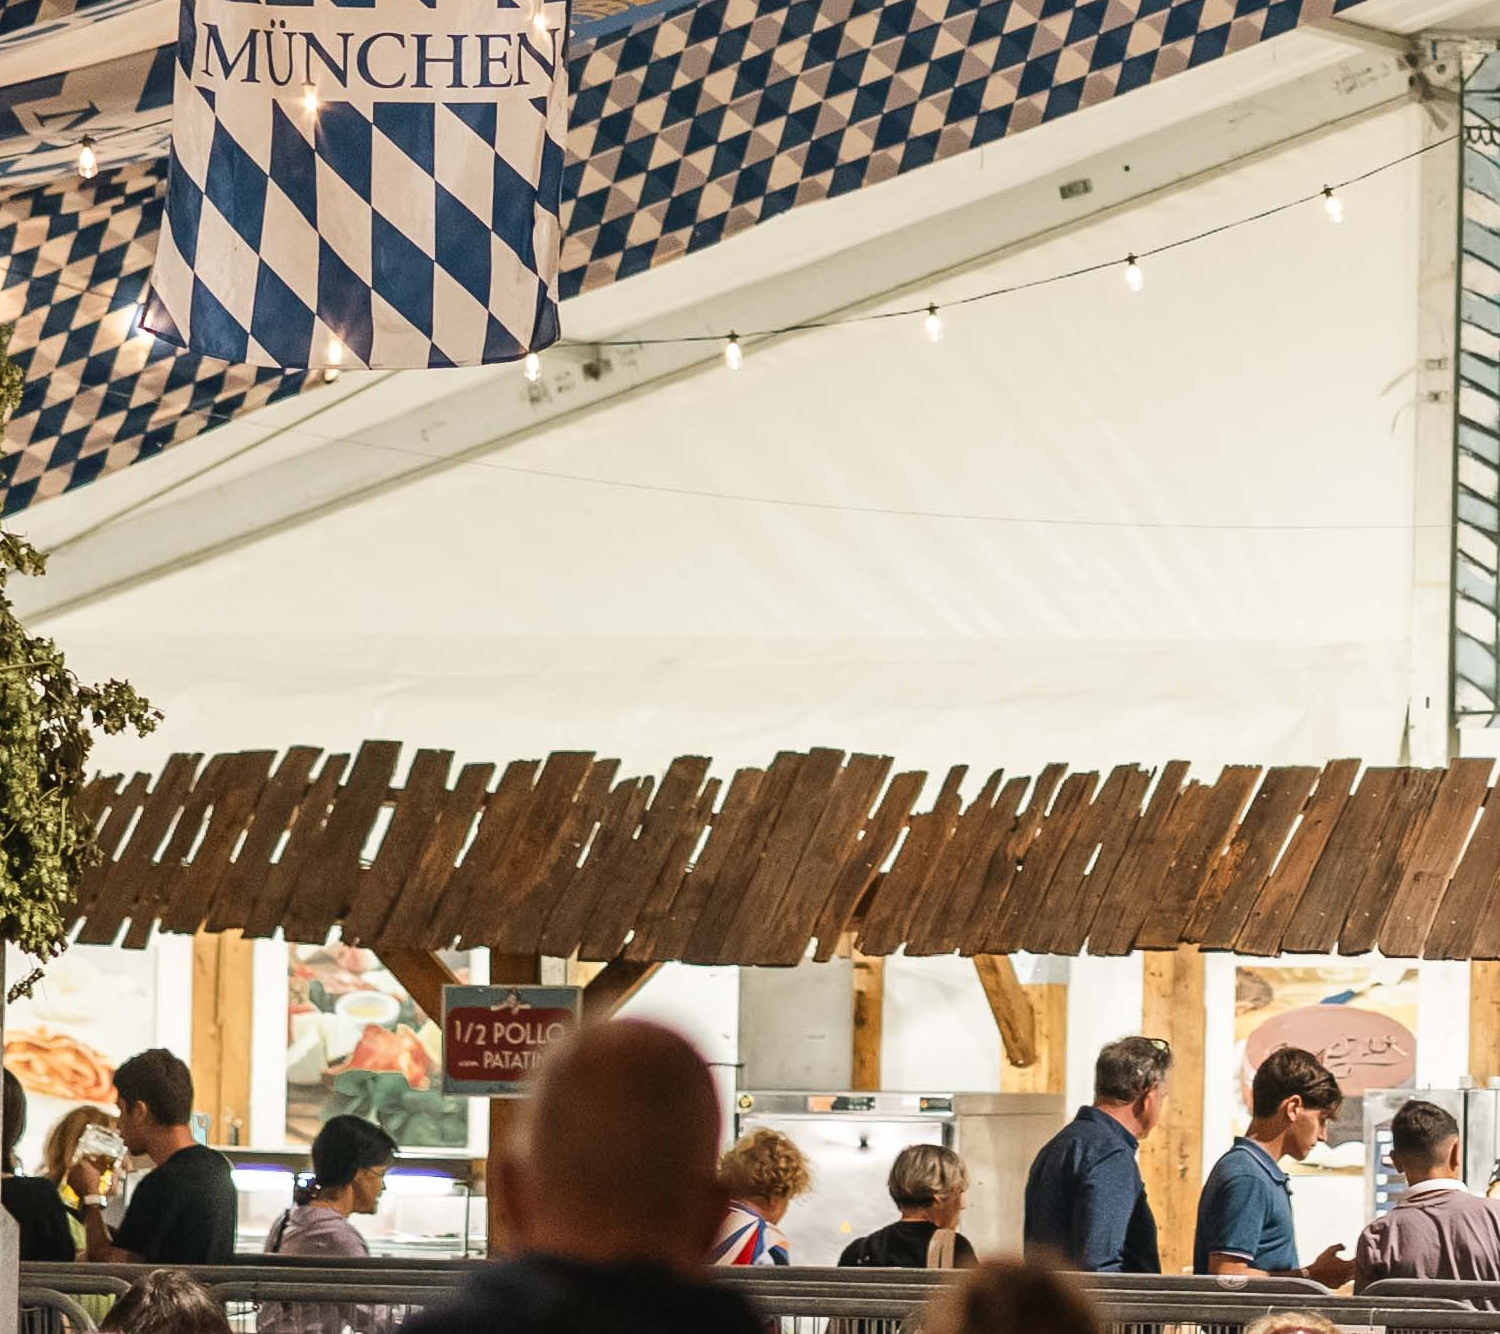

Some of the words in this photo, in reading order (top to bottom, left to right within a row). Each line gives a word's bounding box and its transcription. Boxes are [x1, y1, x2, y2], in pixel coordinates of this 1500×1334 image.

[200, 17, 562, 91] MÜNCHEN
[455, 1020, 487, 1045] 1/2
[493, 1022, 565, 1045] POLLO
